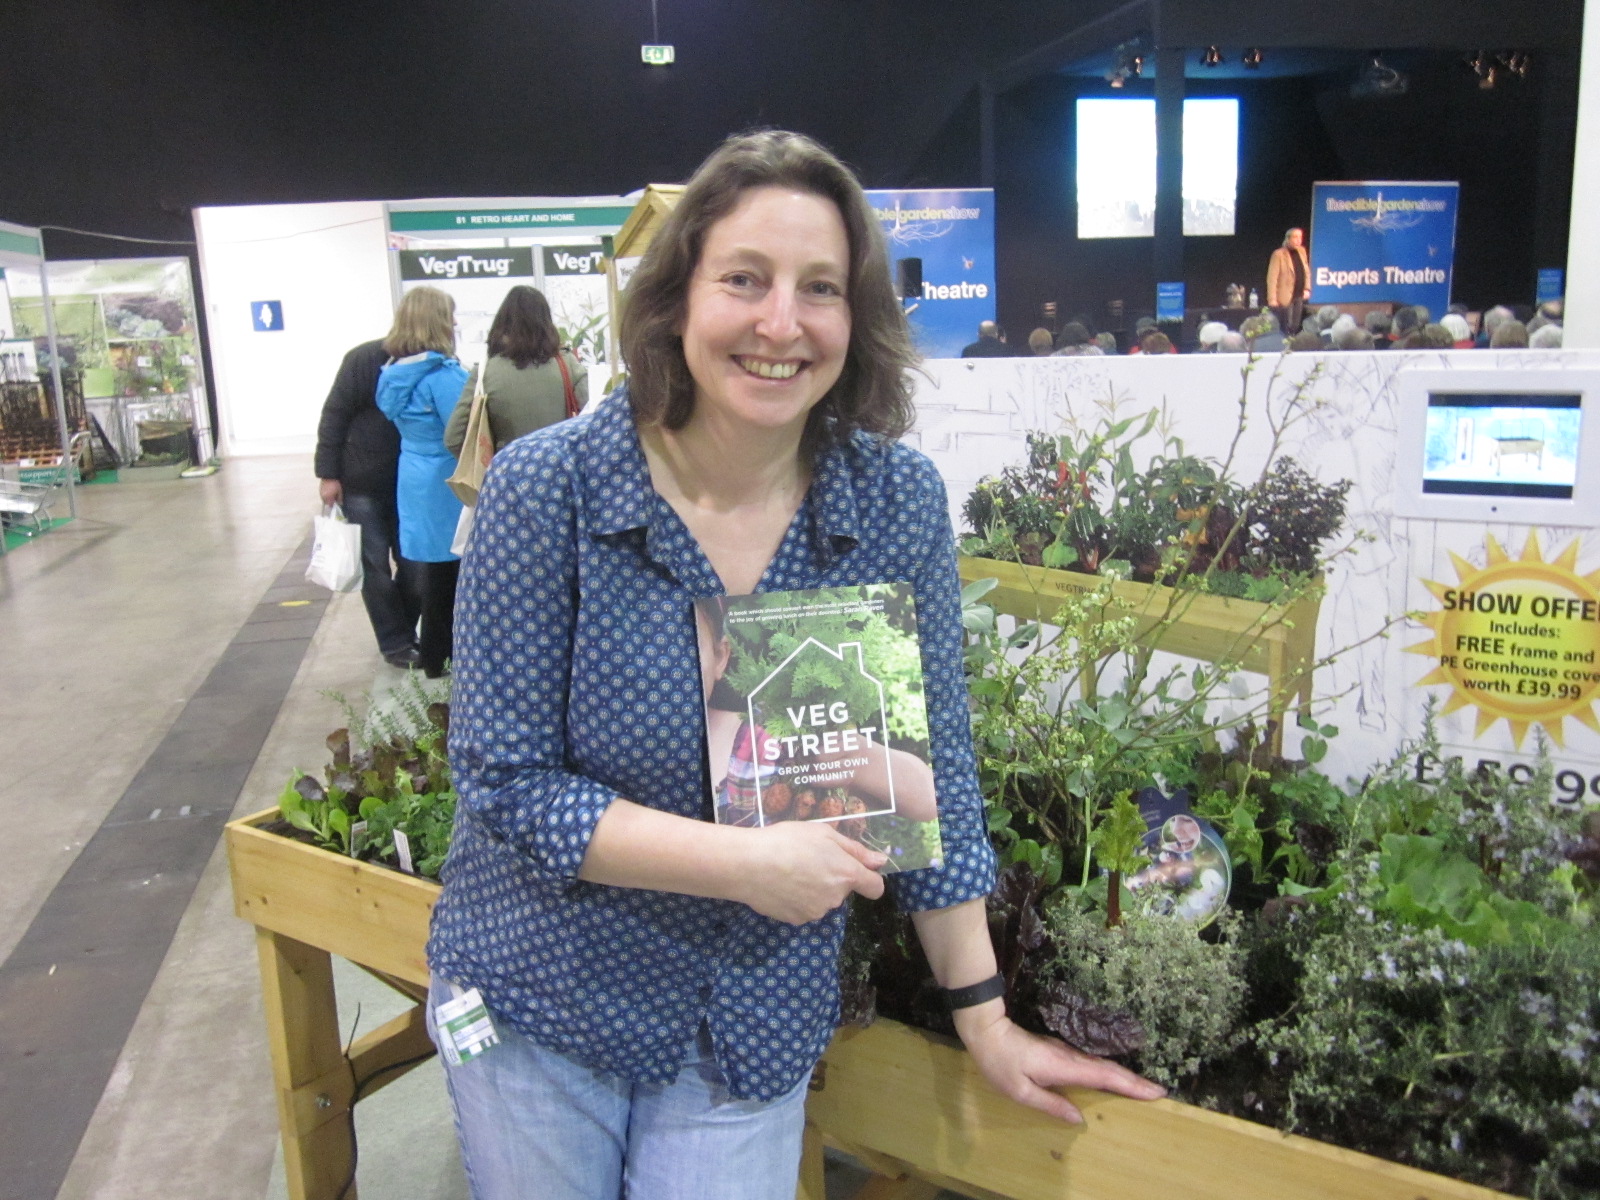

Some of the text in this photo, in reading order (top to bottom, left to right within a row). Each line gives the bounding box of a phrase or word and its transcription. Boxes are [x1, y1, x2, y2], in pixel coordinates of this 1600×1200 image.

[470, 215, 500, 224] RETRO
[502, 214, 530, 223] HEART
[531, 213, 549, 222] AND
[551, 213, 575, 221] HOME
[419, 255, 510, 277] VegTrug
[553, 252, 603, 273] VegT
[1316, 266, 1446, 289] Experts Theatre
[922, 281, 988, 300] heatre
[844, 606, 862, 614] Sarah
[1443, 590, 1600, 622] SHOW OFFE
[1490, 620, 1561, 639] Includes:
[1456, 635, 1595, 664] FREE frame and
[1440, 655, 1600, 683] PE Greenhouse cove
[1463, 678, 1581, 700] worth £39.99
[786, 701, 849, 729] VEG
[763, 727, 876, 761] STREET
[778, 757, 869, 775] GROW YOUR OWN
[794, 770, 855, 785] COMMUNITY
